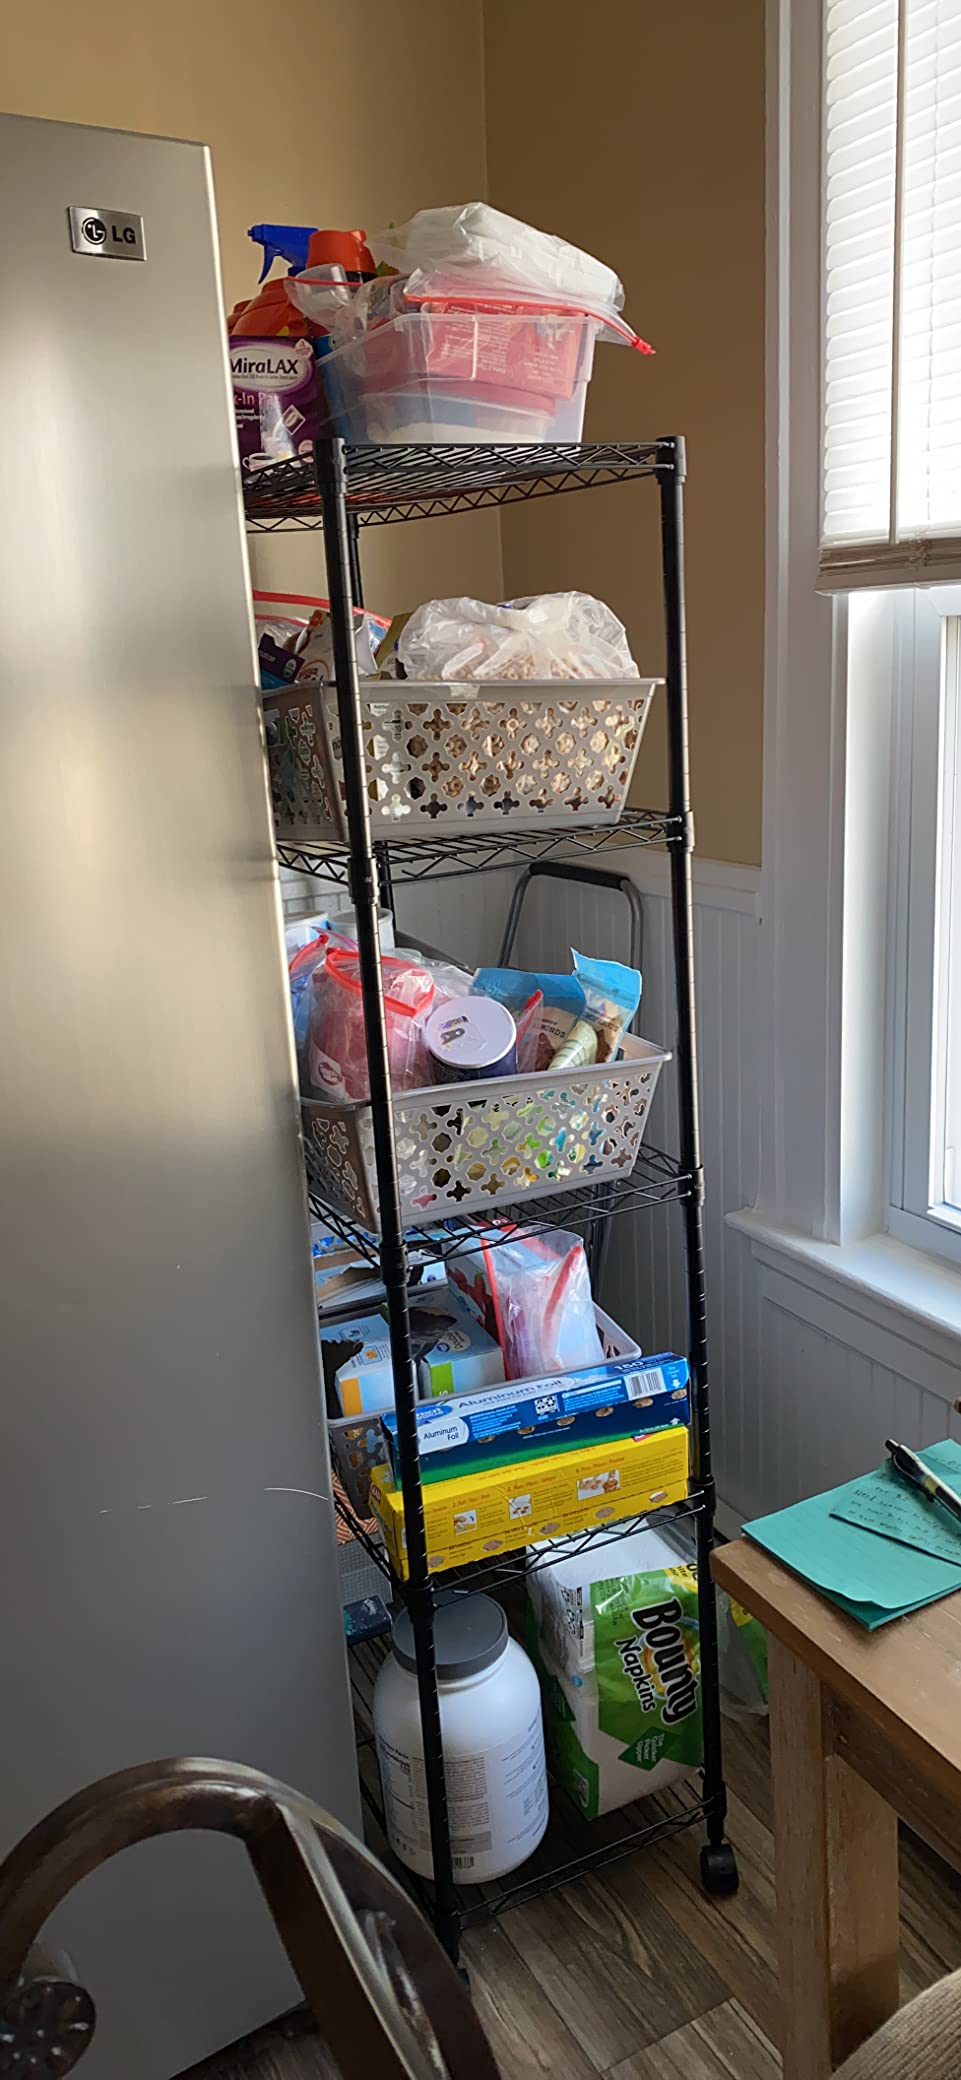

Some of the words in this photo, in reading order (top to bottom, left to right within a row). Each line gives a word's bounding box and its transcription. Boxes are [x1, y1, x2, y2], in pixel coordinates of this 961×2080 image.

[111, 225, 136, 245] LG
[230, 357, 299, 375] MiraLAX
[458, 1385, 535, 1408] Aluminum
[535, 1379, 563, 1391] Foil
[423, 1425, 458, 1440] Aluminum
[447, 1432, 460, 1442] Foil
[631, 1597, 699, 1725] Bounty
[614, 1636, 656, 1713] Napkins
